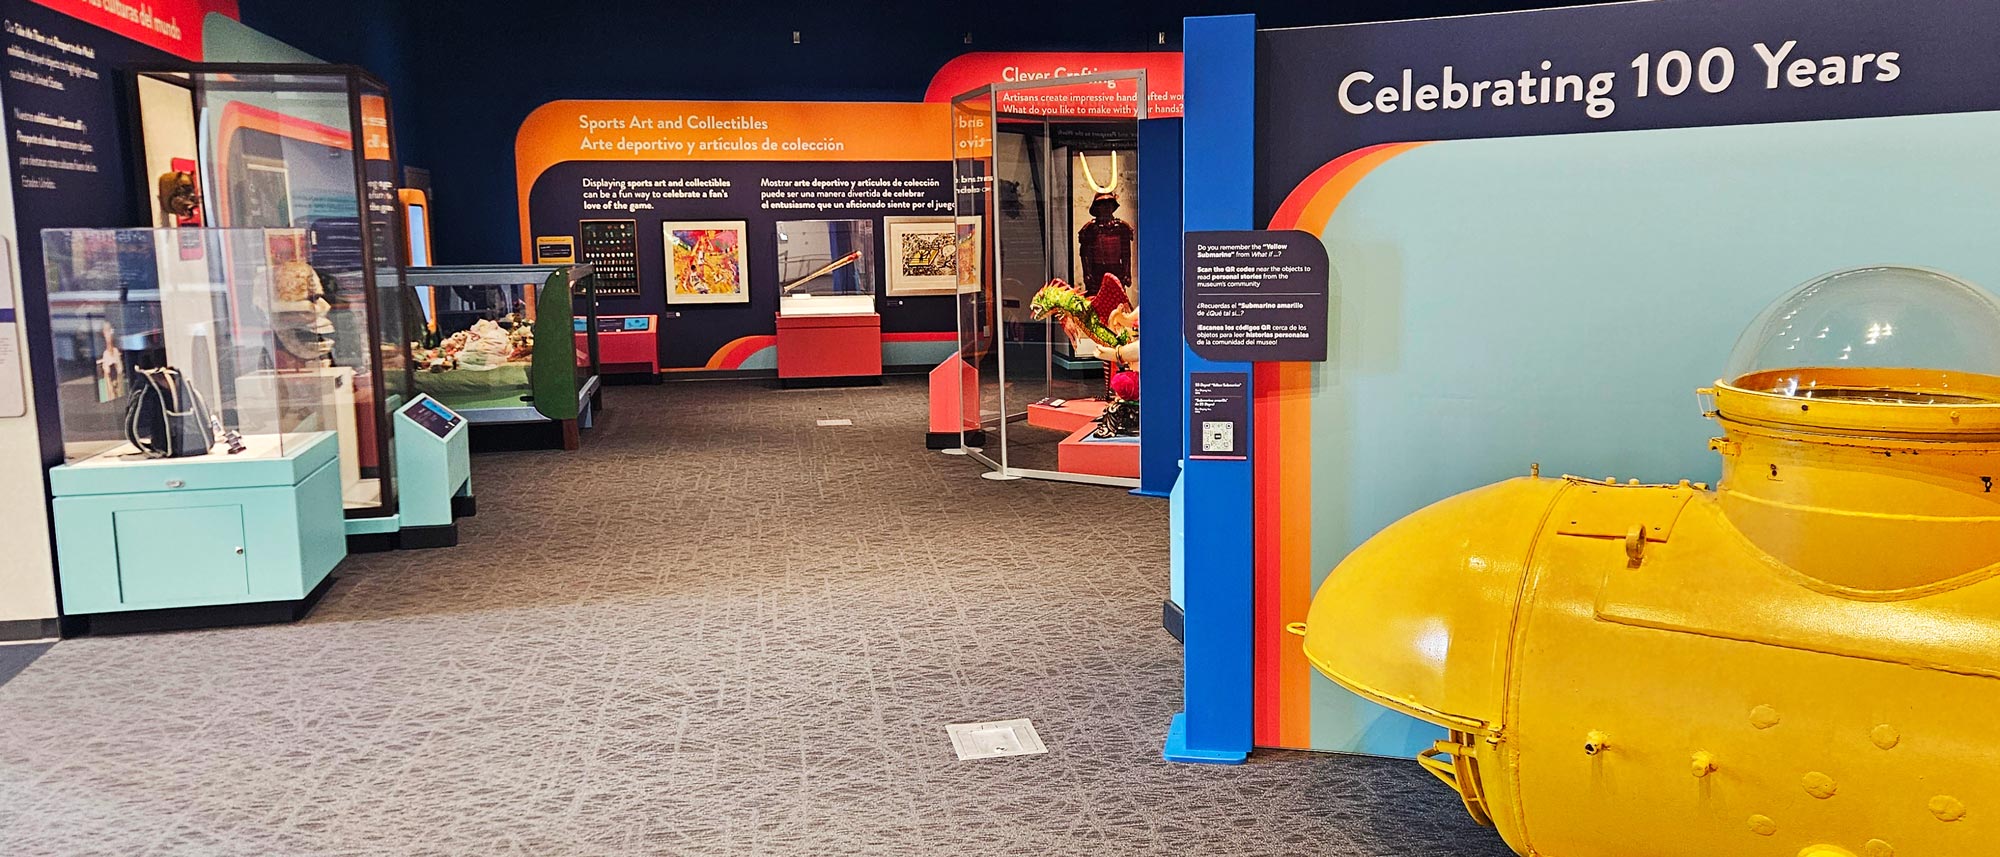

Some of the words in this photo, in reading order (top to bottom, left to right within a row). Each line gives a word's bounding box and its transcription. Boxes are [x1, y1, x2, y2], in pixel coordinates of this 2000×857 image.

[139, 3, 152, 28] del
[152, 17, 182, 40] mundo
[1002, 66, 1050, 82] Clever
[1338, 61, 1615, 118] Celebrating
[1632, 47, 1734, 97] 100
[1753, 41, 1900, 88] Years
[1003, 92, 1038, 102] Artisans
[1070, 92, 1114, 104] impressive
[1003, 104, 1026, 114] What
[1029, 104, 1039, 114] do
[1042, 108, 1057, 116] you
[1060, 104, 1074, 113] like
[1088, 104, 1111, 113] make
[1113, 104, 1131, 113] with
[1155, 104, 1183, 112] hands?
[579, 115, 625, 133] Sports
[629, 115, 653, 129] Art
[657, 116, 683, 129] and
[687, 116, 768, 129] Collectibles
[580, 138, 613, 150] Arte
[617, 137, 683, 155] deportivo
[687, 142, 695, 155] y
[699, 137, 758, 150] artículos
[761, 138, 778, 150] de
[782, 137, 844, 150] colección
[583, 178, 626, 189] Displaying
[627, 180, 652, 189] sports
[812, 179, 849, 189] deportivo
[851, 181, 856, 189] y
[600, 190, 611, 198] be
[619, 190, 634, 198] fun
[634, 192, 650, 200] way
[761, 190, 785, 200] puede
[630, 203, 654, 212] game.
[761, 201, 769, 209] el
[817, 203, 832, 211] que
[912, 203, 925, 211] por
